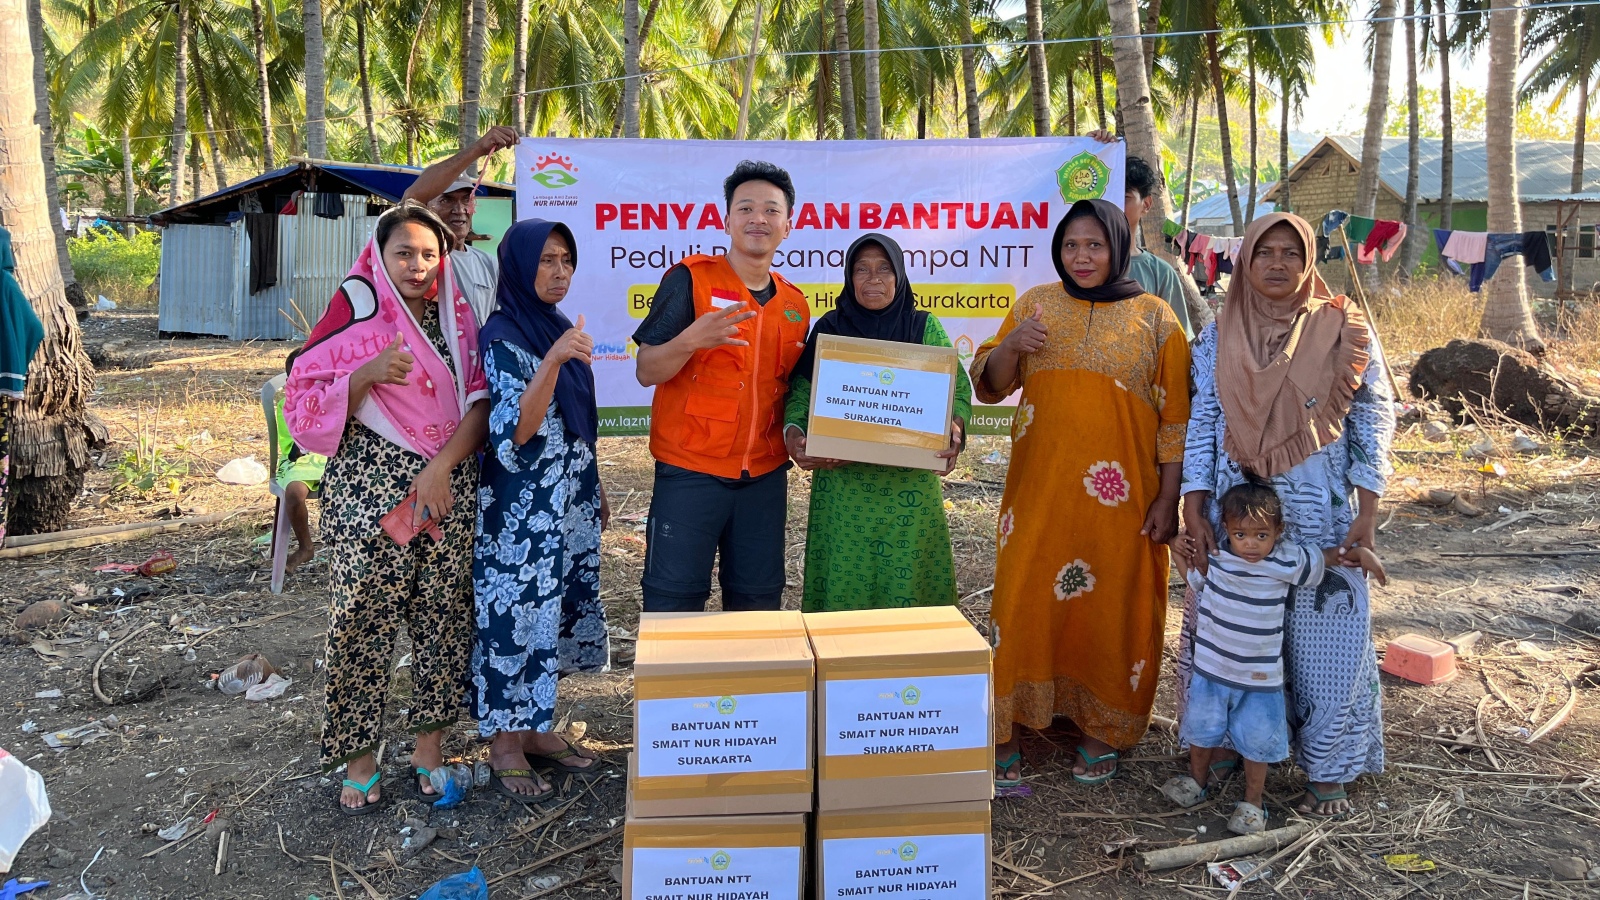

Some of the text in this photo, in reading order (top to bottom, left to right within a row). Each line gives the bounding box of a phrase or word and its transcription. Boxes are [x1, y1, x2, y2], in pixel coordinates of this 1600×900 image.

[595, 202, 1049, 230] PENYAAN BANTUAN
[902, 249, 969, 275] mpa
[980, 245, 1034, 268] NTT
[913, 291, 1010, 309] Surakarta
[842, 384, 910, 399] BANTUAN NTT
[826, 396, 923, 415] SMAIT NUR HIDAYAH
[844, 412, 902, 426] SURAKARTA
[857, 710, 942, 722] BANTUAN NTT
[671, 720, 759, 731] BANTUAN NTT
[839, 726, 959, 740] SMAIT NUR HIDAYAH
[652, 736, 777, 749] SMAIT NUR HIDAYAH
[863, 744, 935, 755] SURAKARTA
[677, 754, 752, 765] SURAKARTA
[856, 865, 939, 878] BANTUAN NTT
[665, 875, 752, 885] BANTUAN NTT
[837, 880, 957, 897] SMAIT NUR HIDAYAH
[717, 891, 769, 900] HIDAYAH
